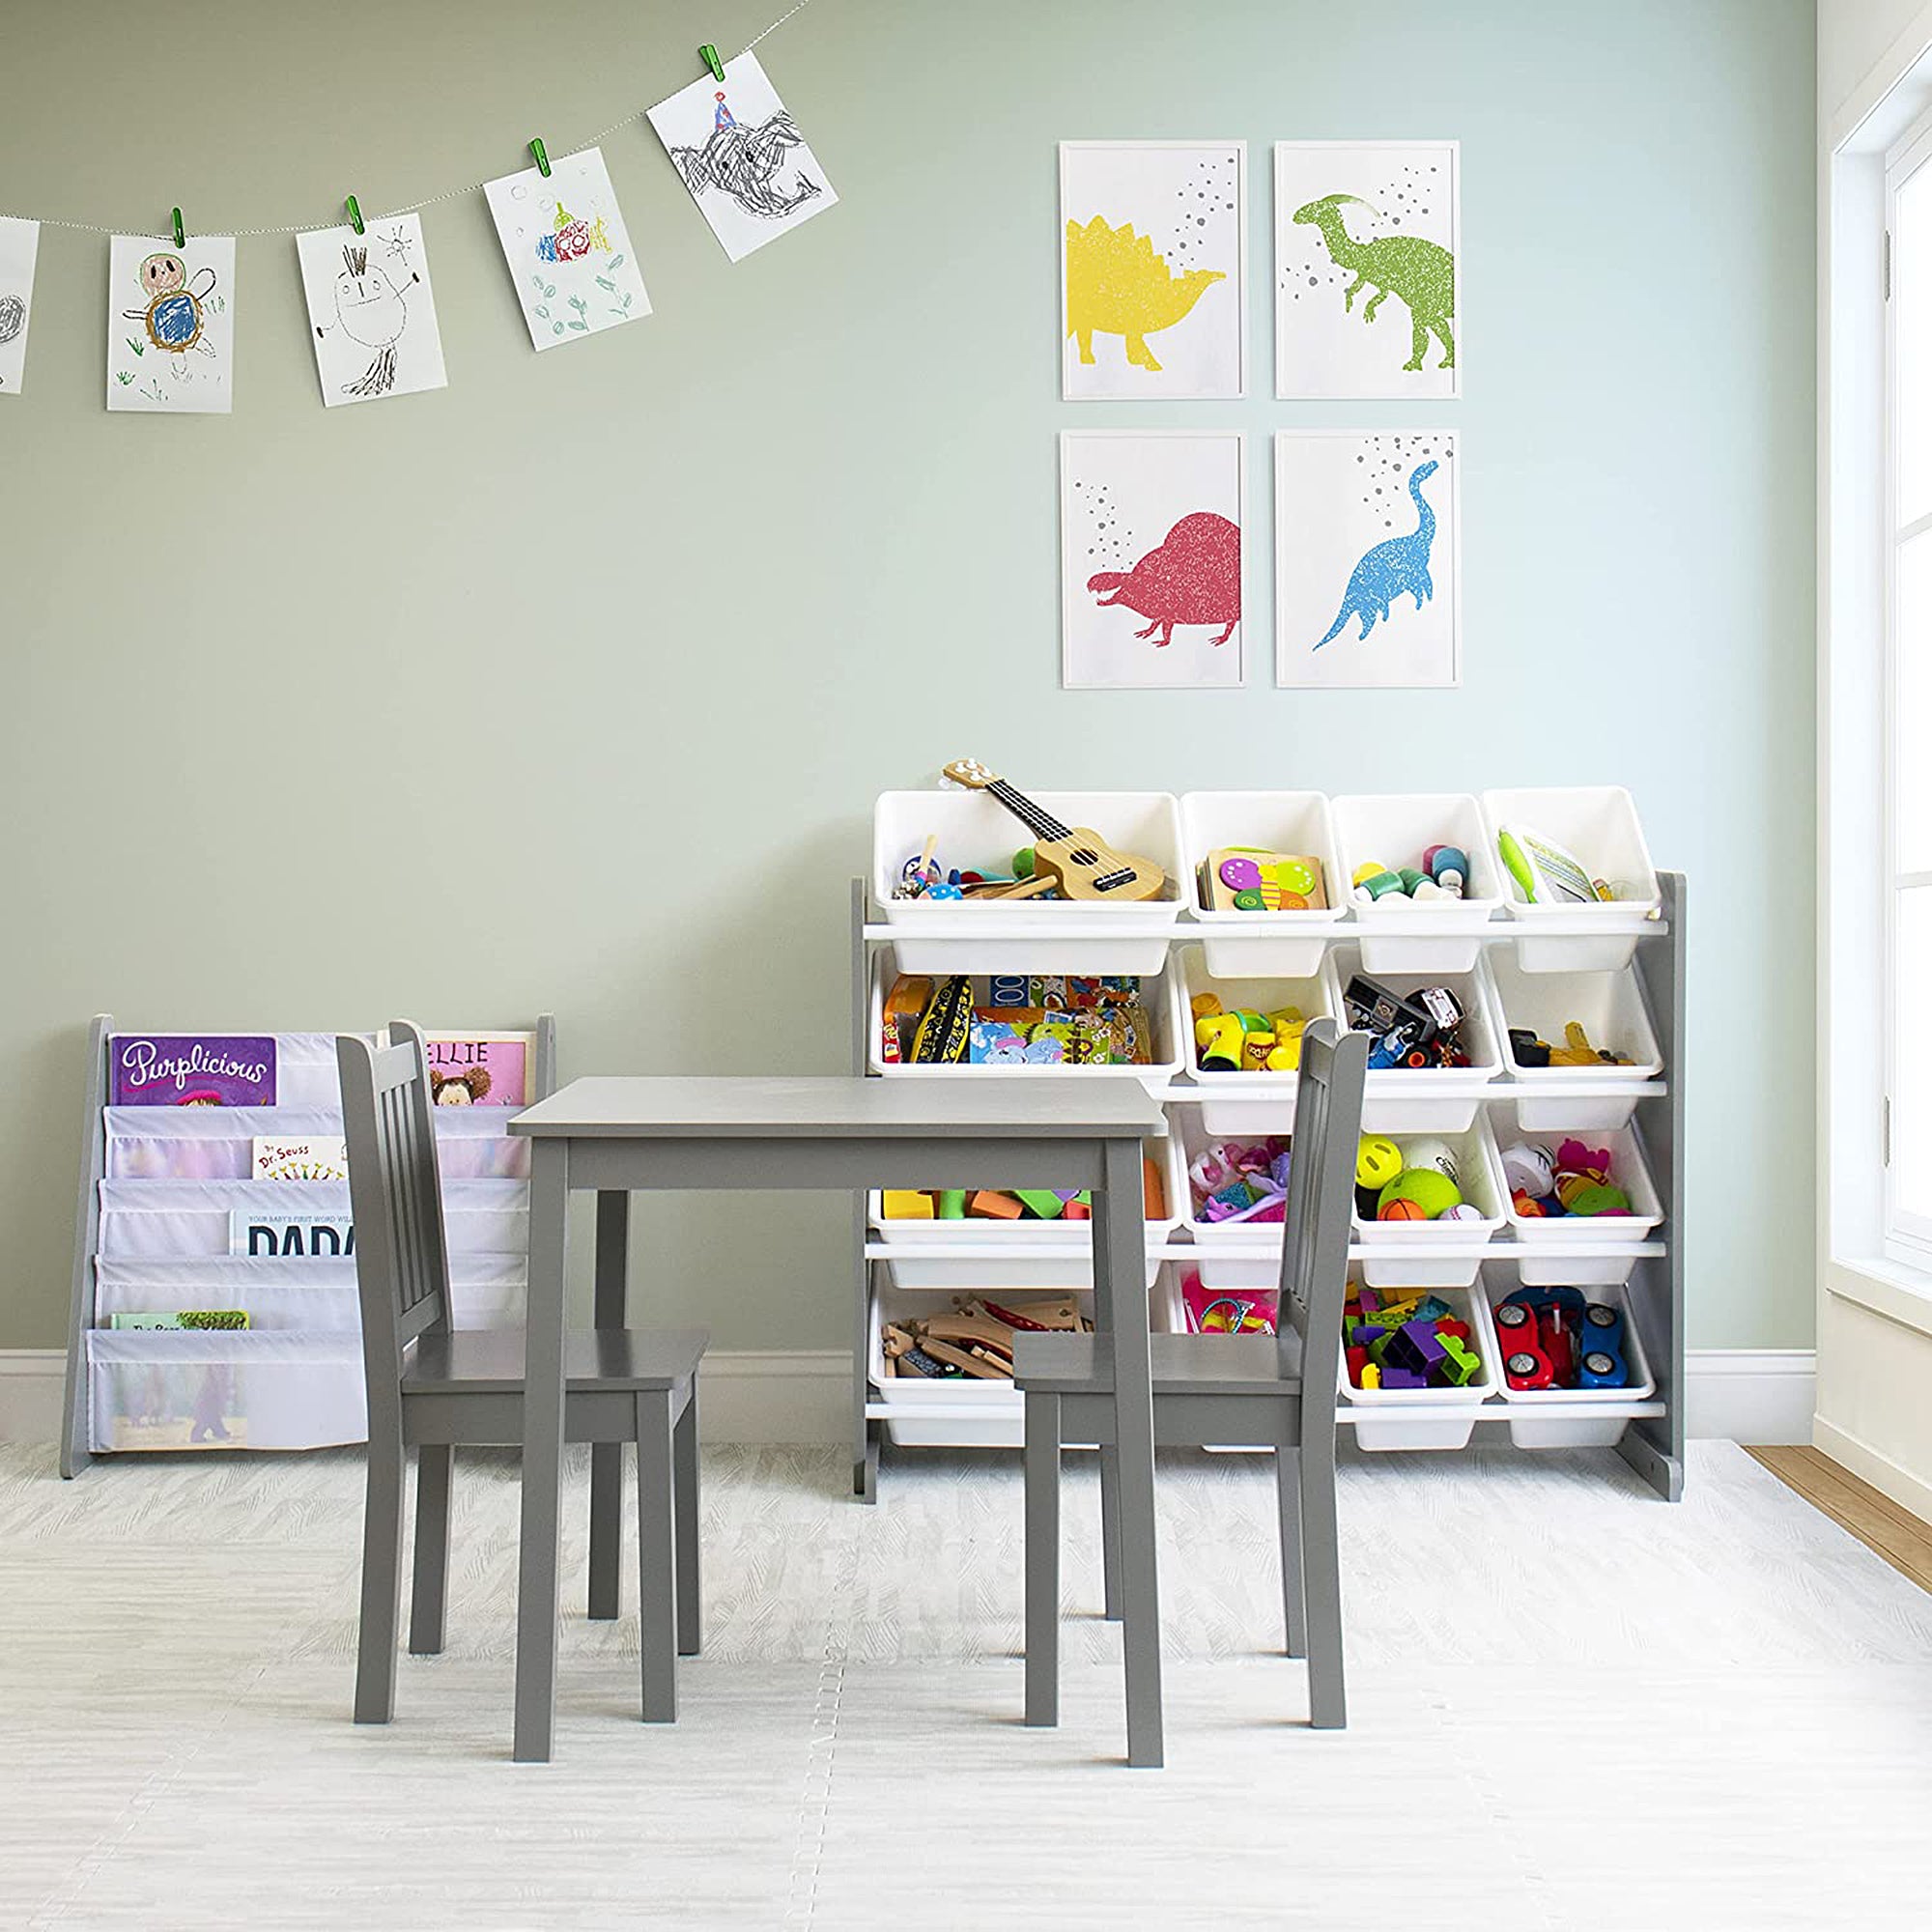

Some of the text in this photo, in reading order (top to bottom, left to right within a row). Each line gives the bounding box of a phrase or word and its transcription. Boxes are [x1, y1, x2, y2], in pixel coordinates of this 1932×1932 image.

[122, 1040, 268, 1090] Purplicious
[258, 1145, 309, 1169] Dr. Seuss
